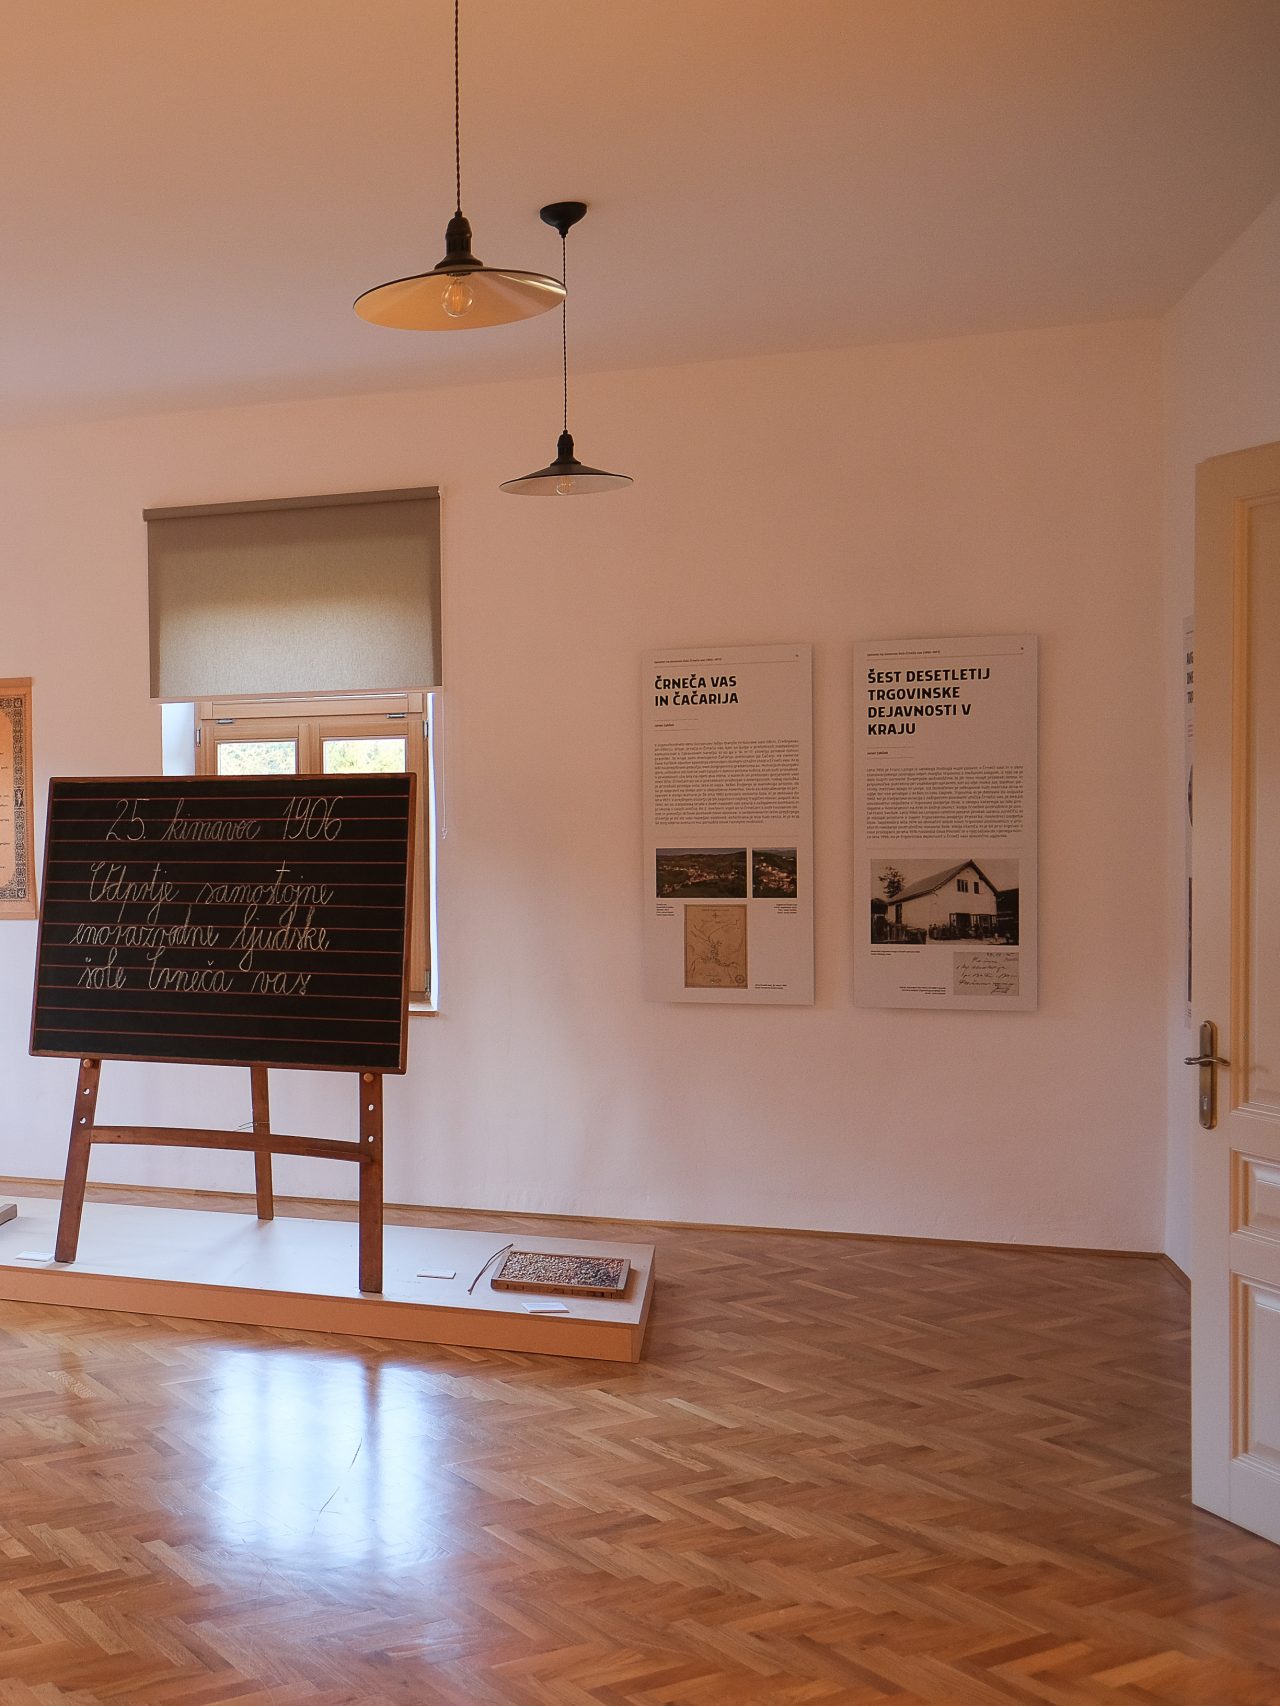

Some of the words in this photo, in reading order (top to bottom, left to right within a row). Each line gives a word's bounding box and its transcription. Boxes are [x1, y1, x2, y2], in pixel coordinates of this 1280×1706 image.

[654, 674, 707, 690] ČRNEČA
[710, 675, 737, 688] VAS
[867, 669, 902, 684] ŠEST
[906, 667, 991, 683] DESETLETIJ
[654, 695, 669, 707] IN
[672, 690, 739, 706] ČAČARIJA
[867, 686, 961, 701] TRGOVINSKE
[867, 704, 957, 719] DEJAVNOSTI
[961, 703, 972, 716] V
[867, 723, 916, 736] KRAJU
[282, 796, 344, 842] 1906
[195, 859, 334, 928] samostojne
[228, 902, 330, 973] ljudske
